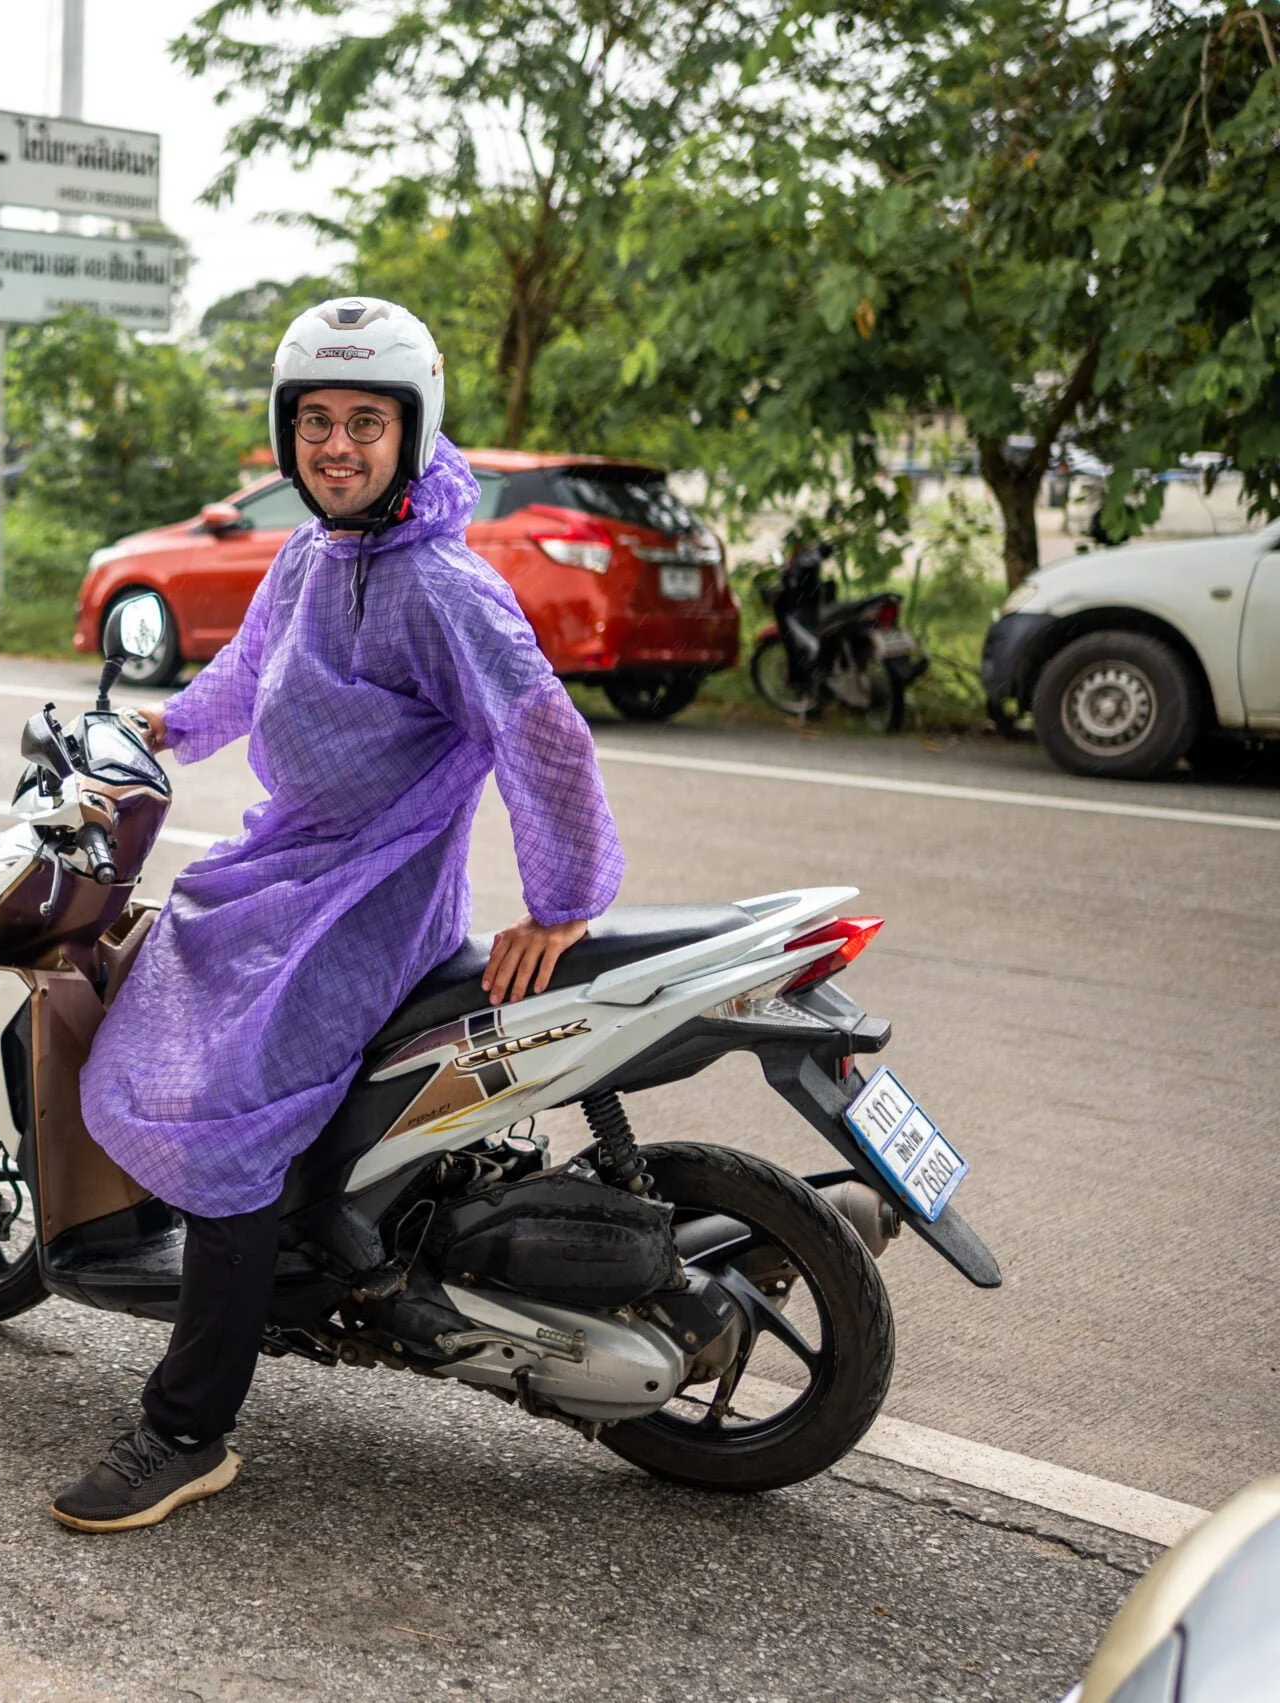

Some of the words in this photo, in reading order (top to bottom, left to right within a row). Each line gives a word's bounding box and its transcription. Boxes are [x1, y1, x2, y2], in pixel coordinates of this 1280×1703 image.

[455, 1019, 592, 1067] CLICK
[407, 1102, 451, 1127] PGM-FI
[894, 1124, 924, 1164] เชียงใหม่
[913, 1148, 955, 1207] 7680
